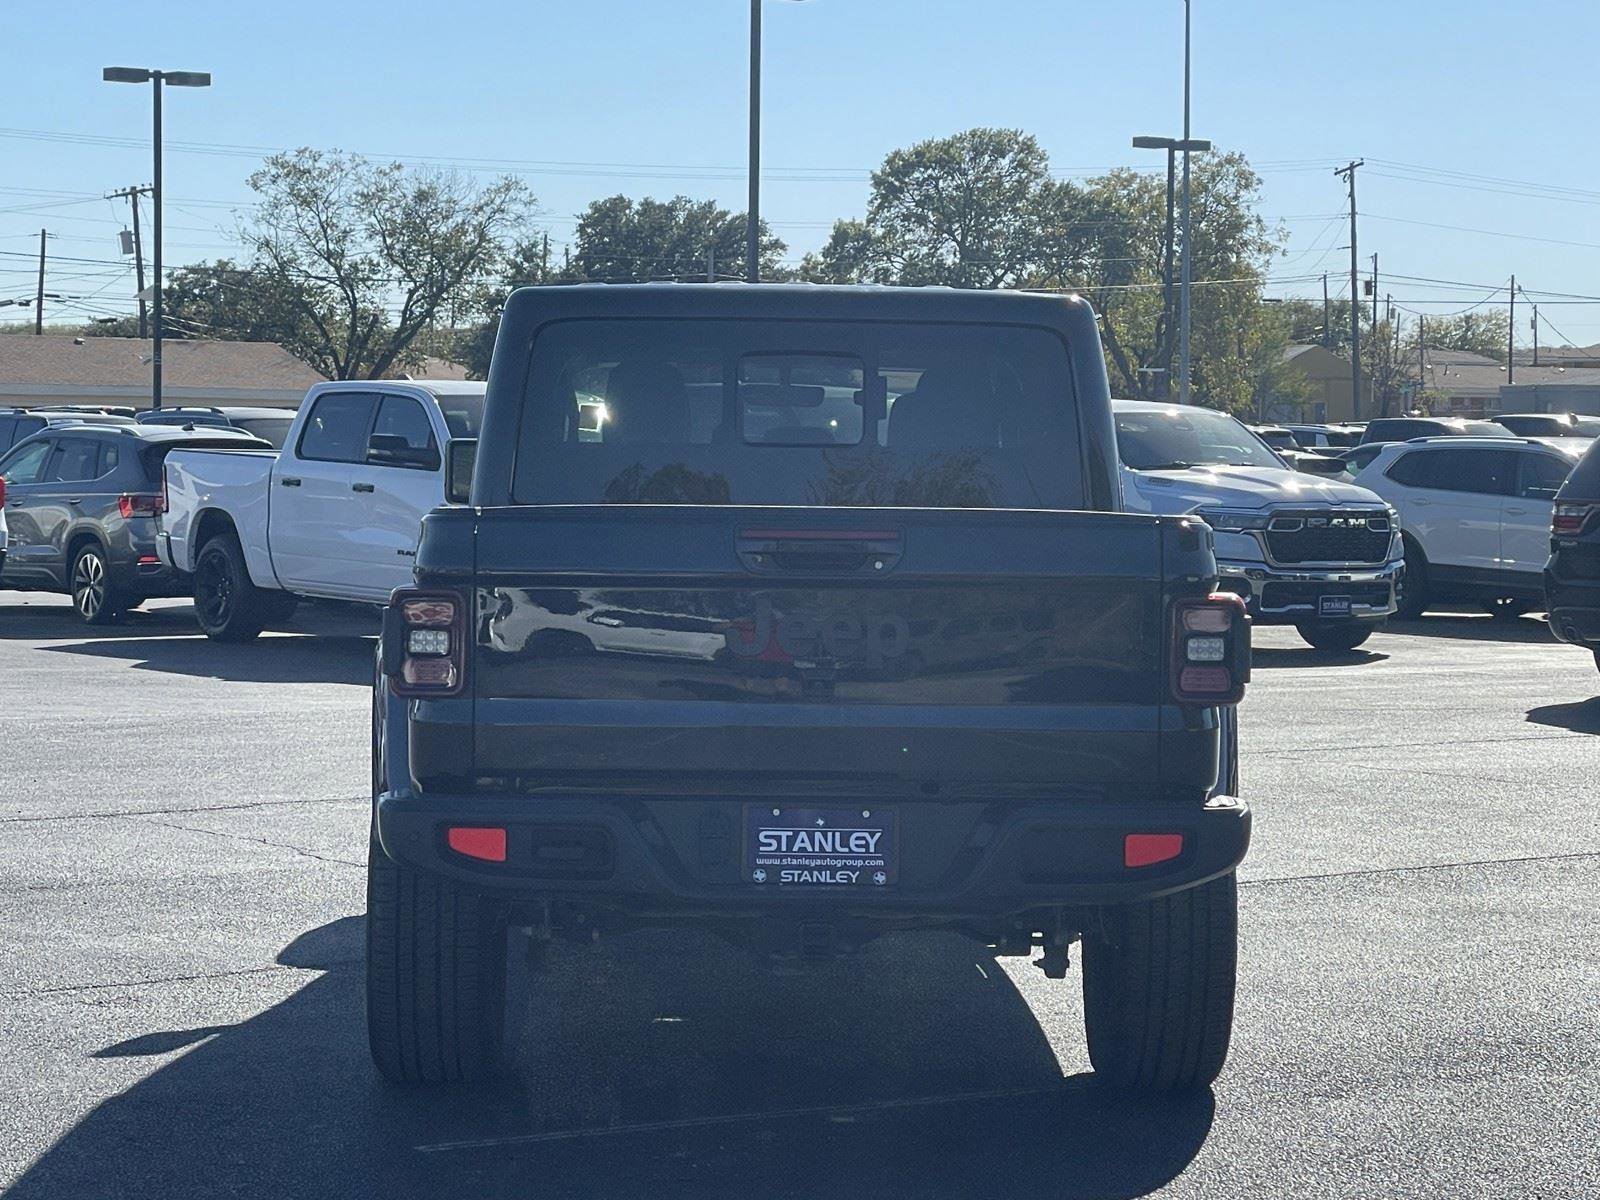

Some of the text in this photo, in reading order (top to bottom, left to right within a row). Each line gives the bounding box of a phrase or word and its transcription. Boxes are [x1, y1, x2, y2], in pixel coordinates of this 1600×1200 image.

[1307, 518, 1366, 528] RAM
[726, 599, 910, 672] Jeep
[758, 830, 882, 853] STANLEY
[756, 857, 884, 867] www.stanleyautogroup.com
[780, 870, 860, 883] STANLEY
